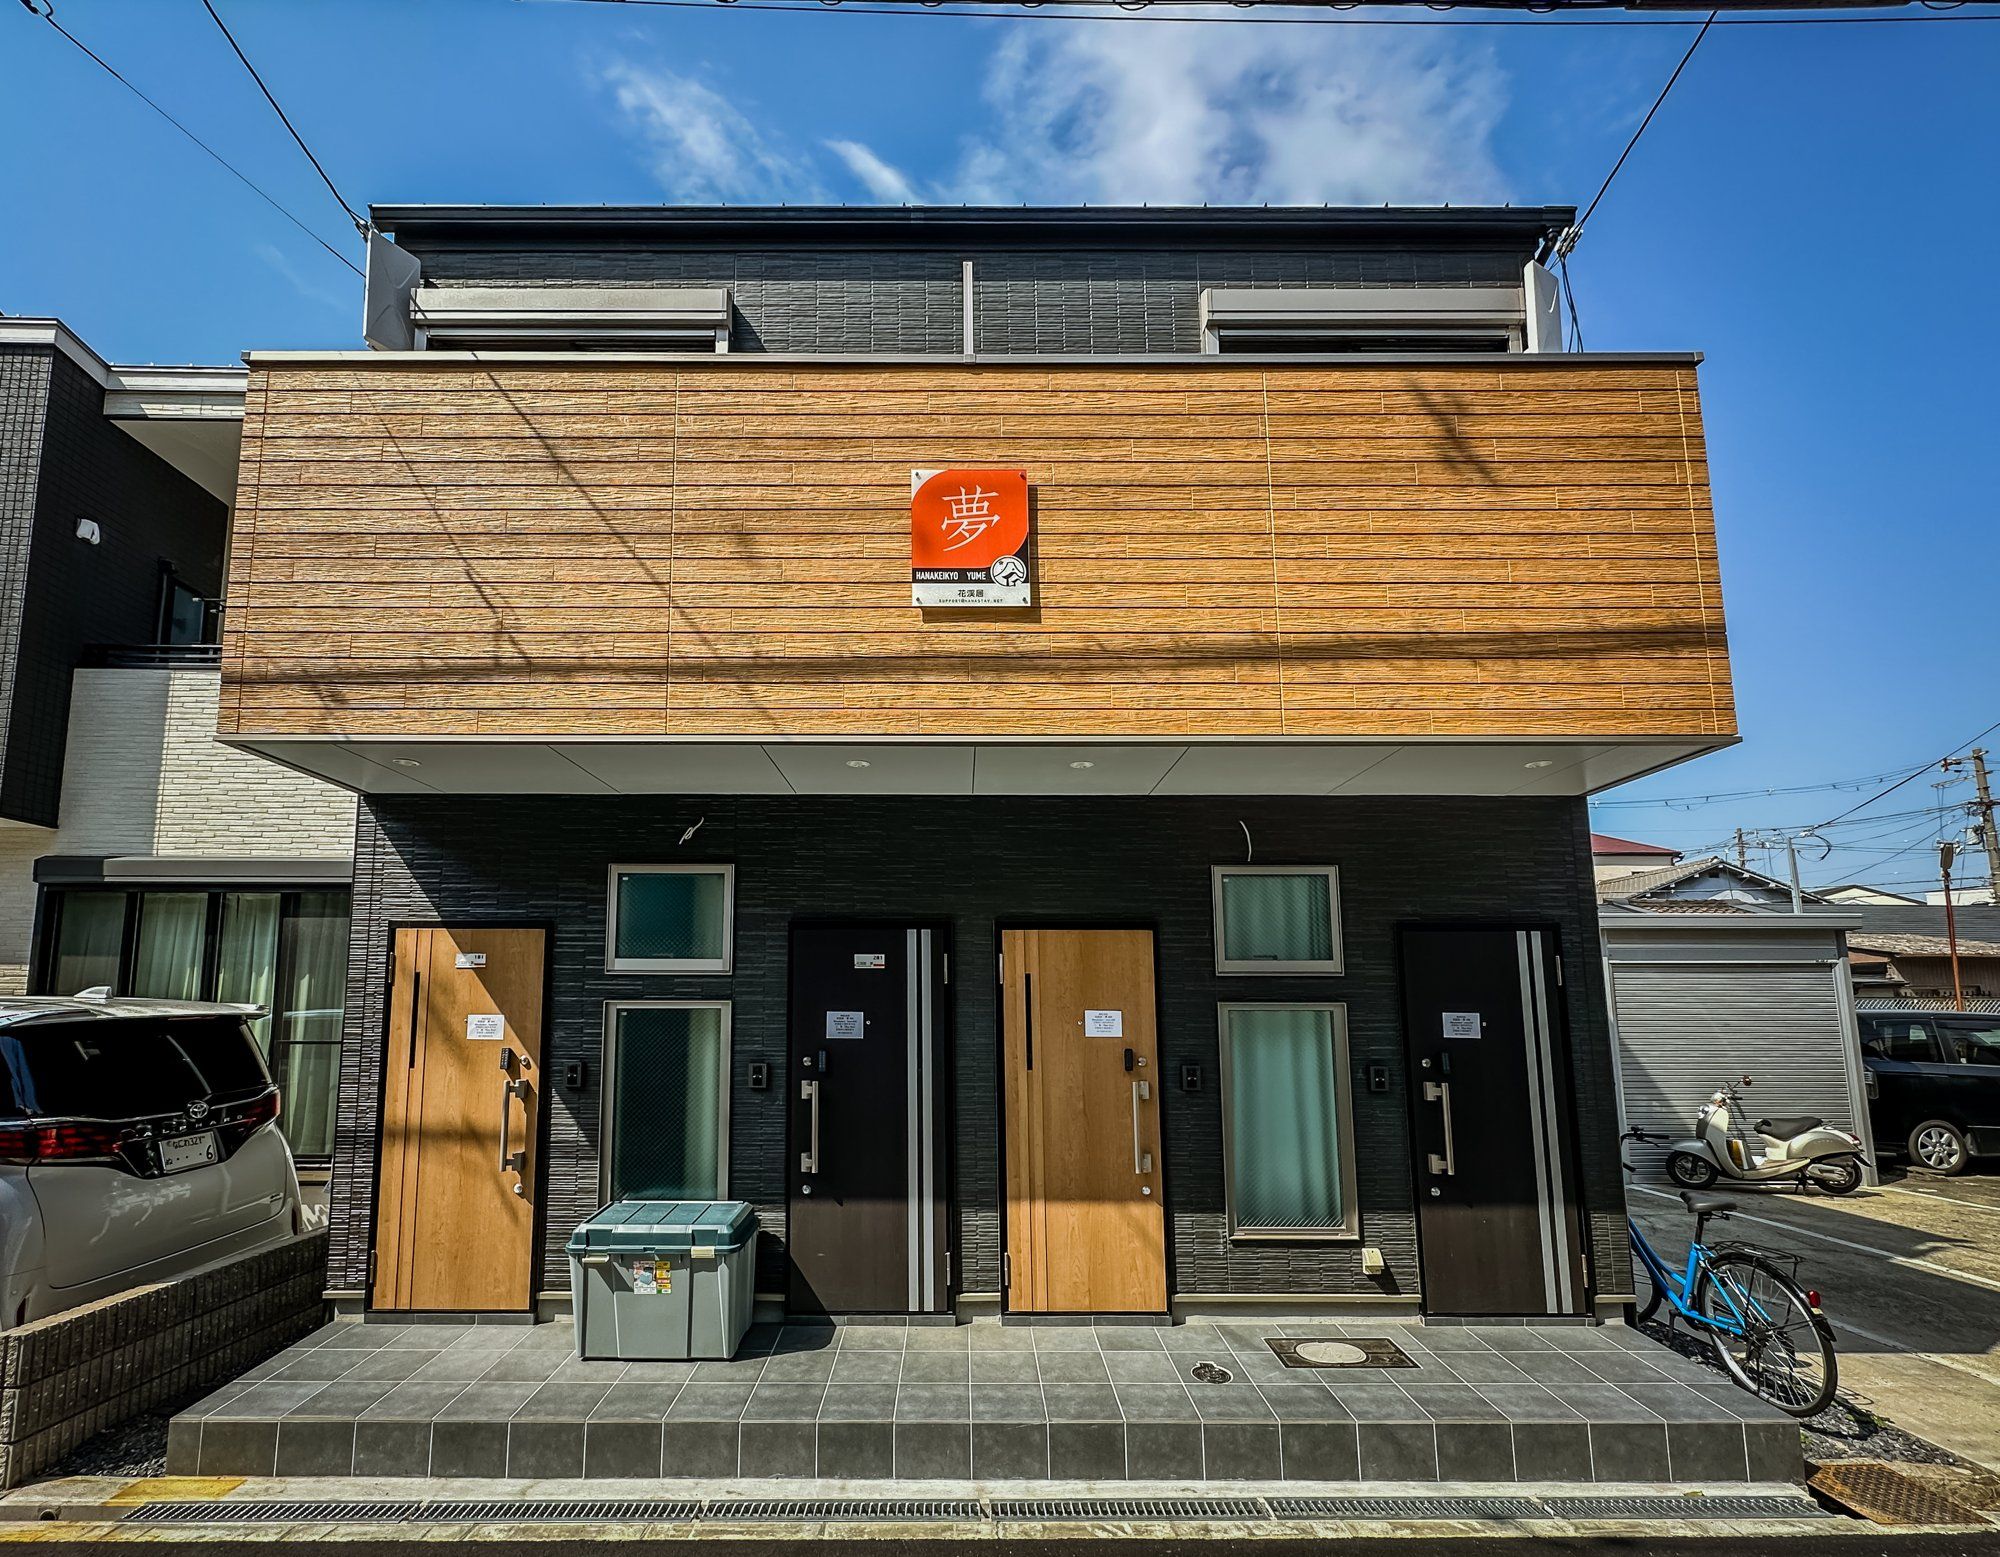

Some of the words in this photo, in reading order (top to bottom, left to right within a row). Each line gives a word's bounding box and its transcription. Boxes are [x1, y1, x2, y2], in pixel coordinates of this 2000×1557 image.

[940, 484, 1001, 552] 夢
[915, 571, 959, 581] HANAKEIKYO
[966, 571, 987, 580] YUME
[143, 1114, 243, 1137] ALPHARD
